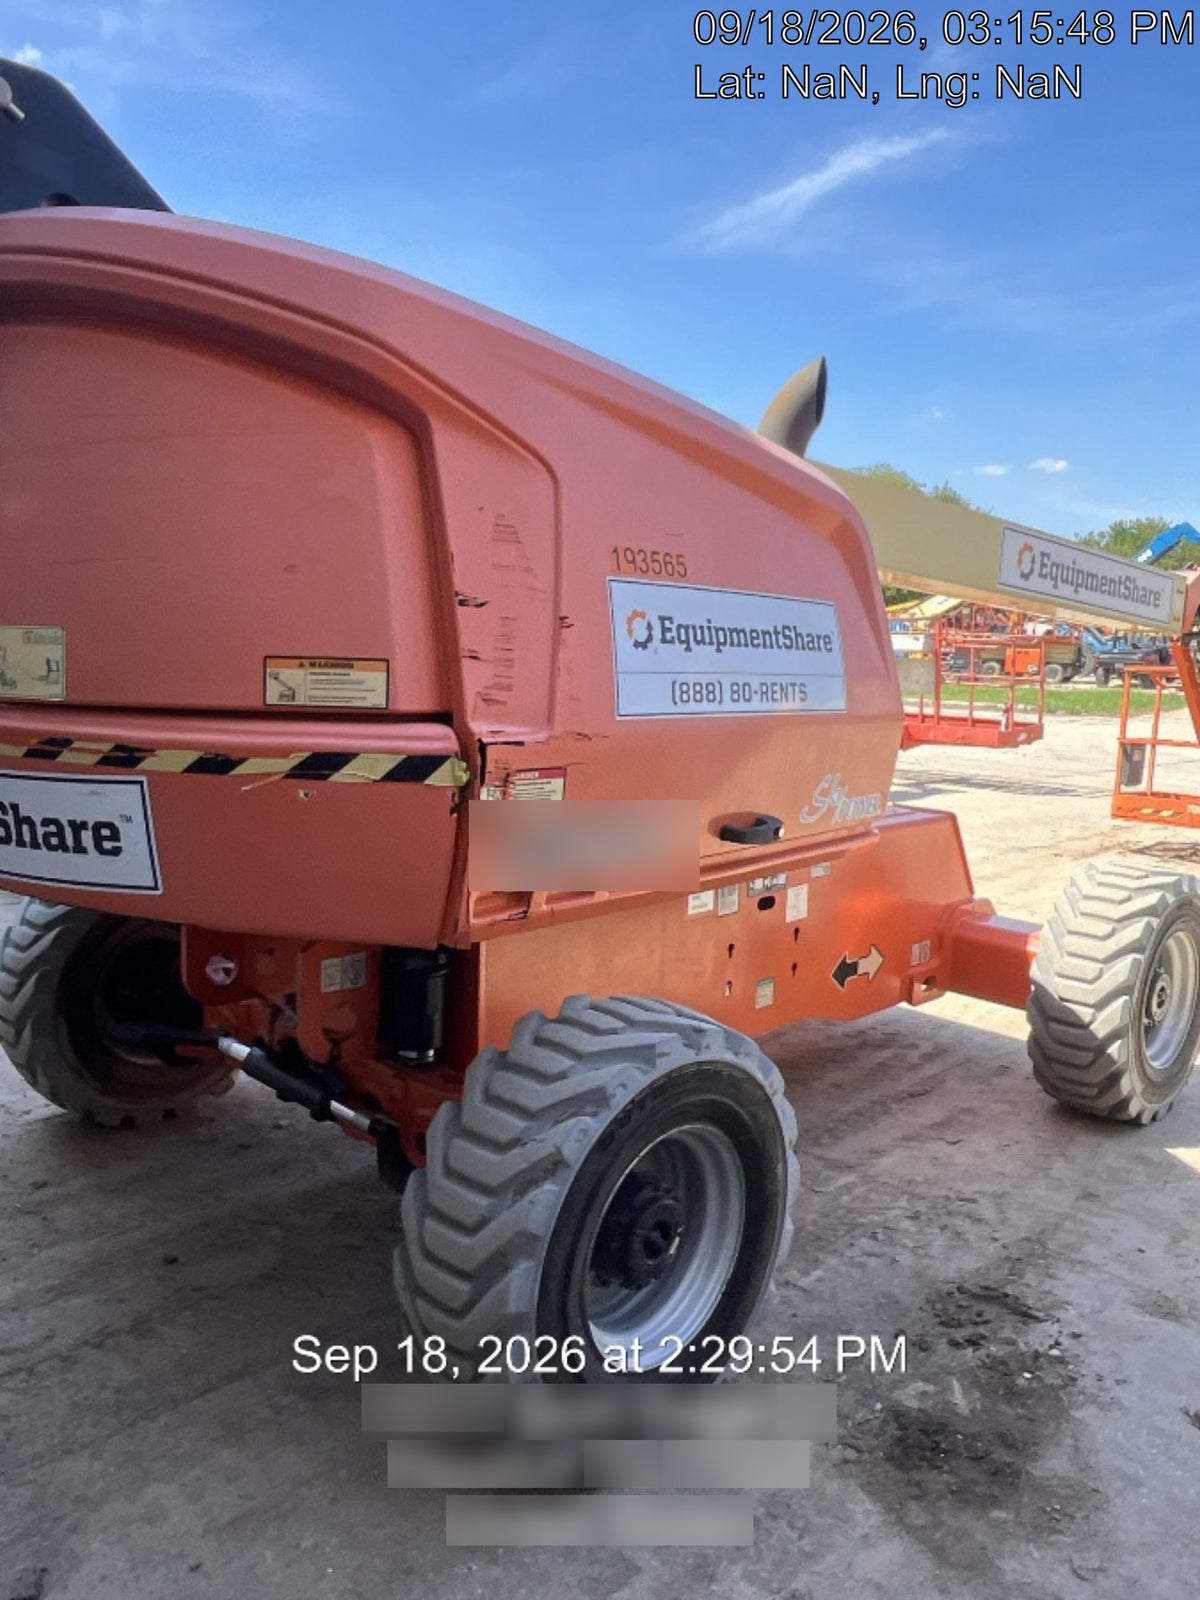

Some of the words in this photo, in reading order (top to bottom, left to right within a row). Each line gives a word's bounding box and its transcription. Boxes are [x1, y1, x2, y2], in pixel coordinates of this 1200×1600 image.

[611, 546, 688, 578] 193565
[1038, 550, 1161, 609] EquipmentShare
[658, 615, 833, 654] EquipmentShare
[671, 680, 723, 705] (888)
[730, 682, 808, 703] 80-RENTS
